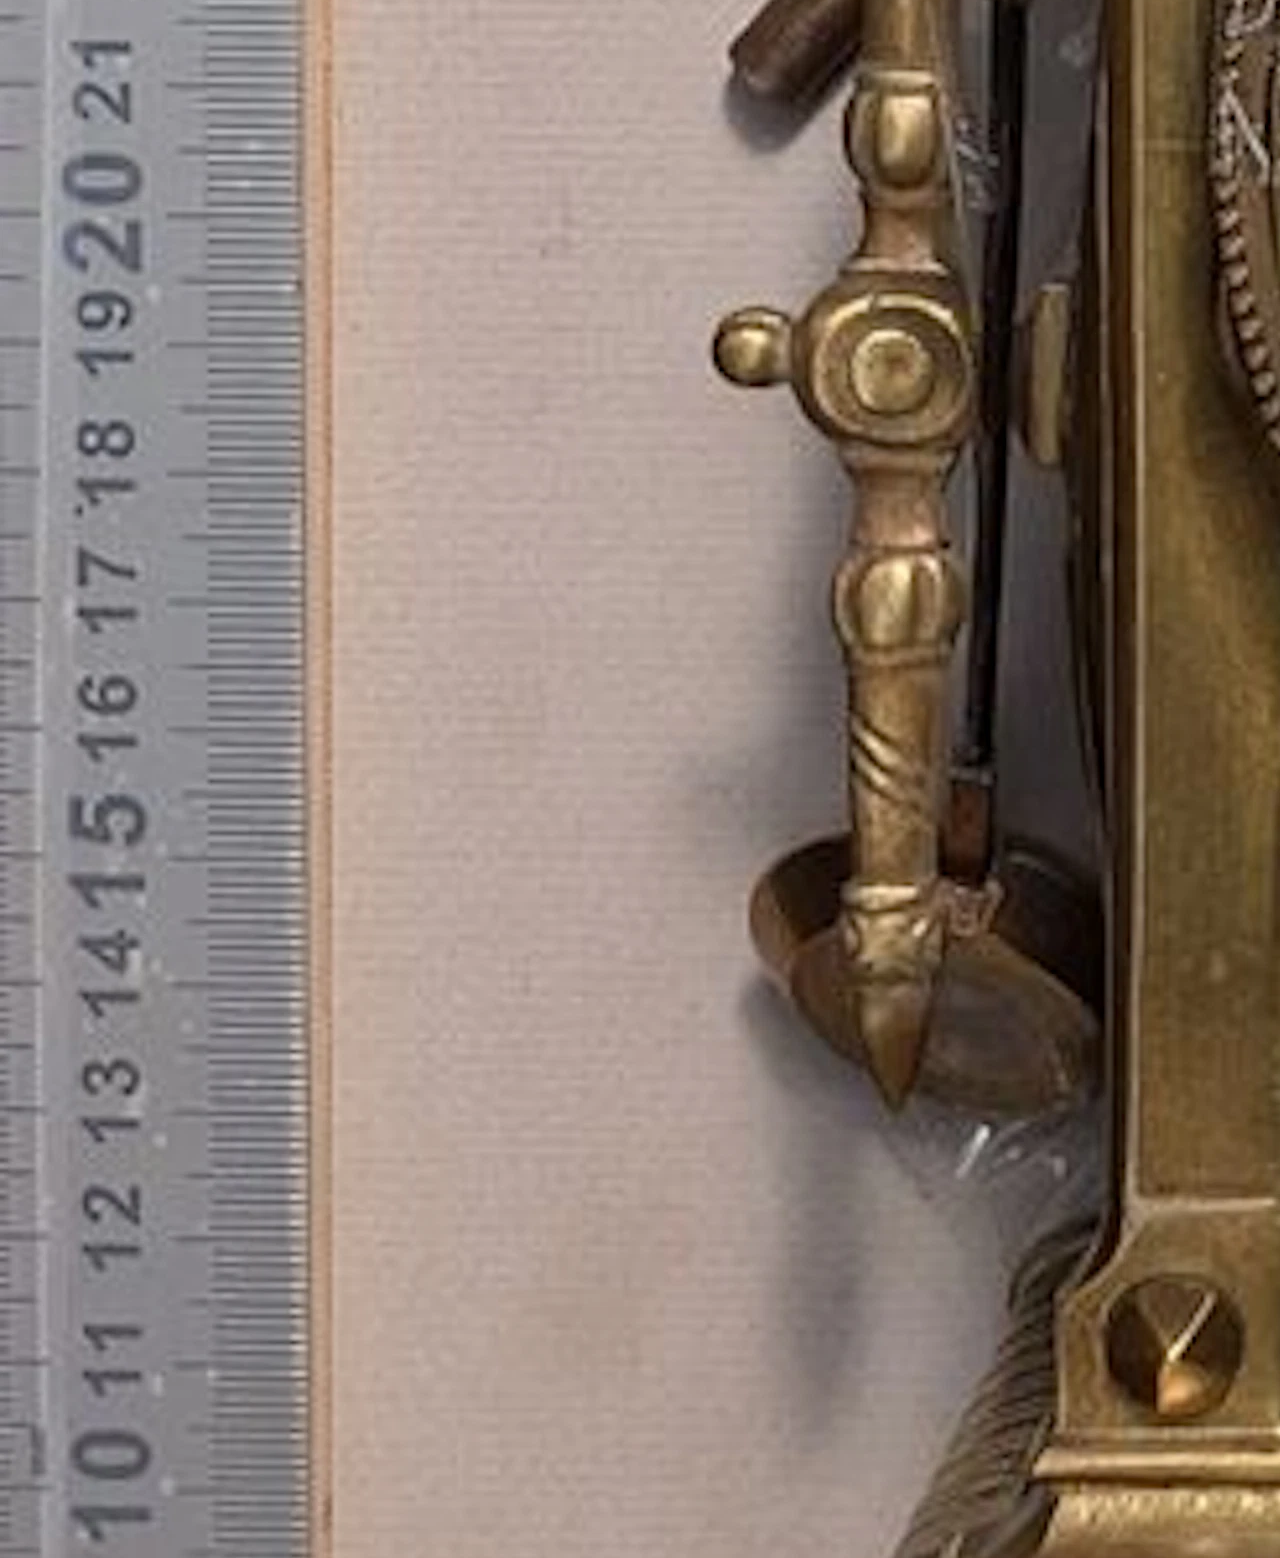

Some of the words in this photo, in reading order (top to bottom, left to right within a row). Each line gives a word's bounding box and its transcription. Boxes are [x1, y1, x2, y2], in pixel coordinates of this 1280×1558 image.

[71, 41, 132, 124] 21
[63, 154, 142, 273] 20
[75, 291, 134, 376] 19
[76, 421, 136, 506] 18
[77, 546, 138, 634] 17
[77, 676, 138, 762] 16
[69, 795, 146, 909] 15
[78, 930, 140, 1018] 14
[80, 1059, 140, 1143] 13
[81, 1186, 141, 1272] 12
[82, 1324, 142, 1396] 11
[71, 1431, 151, 1541] 10
